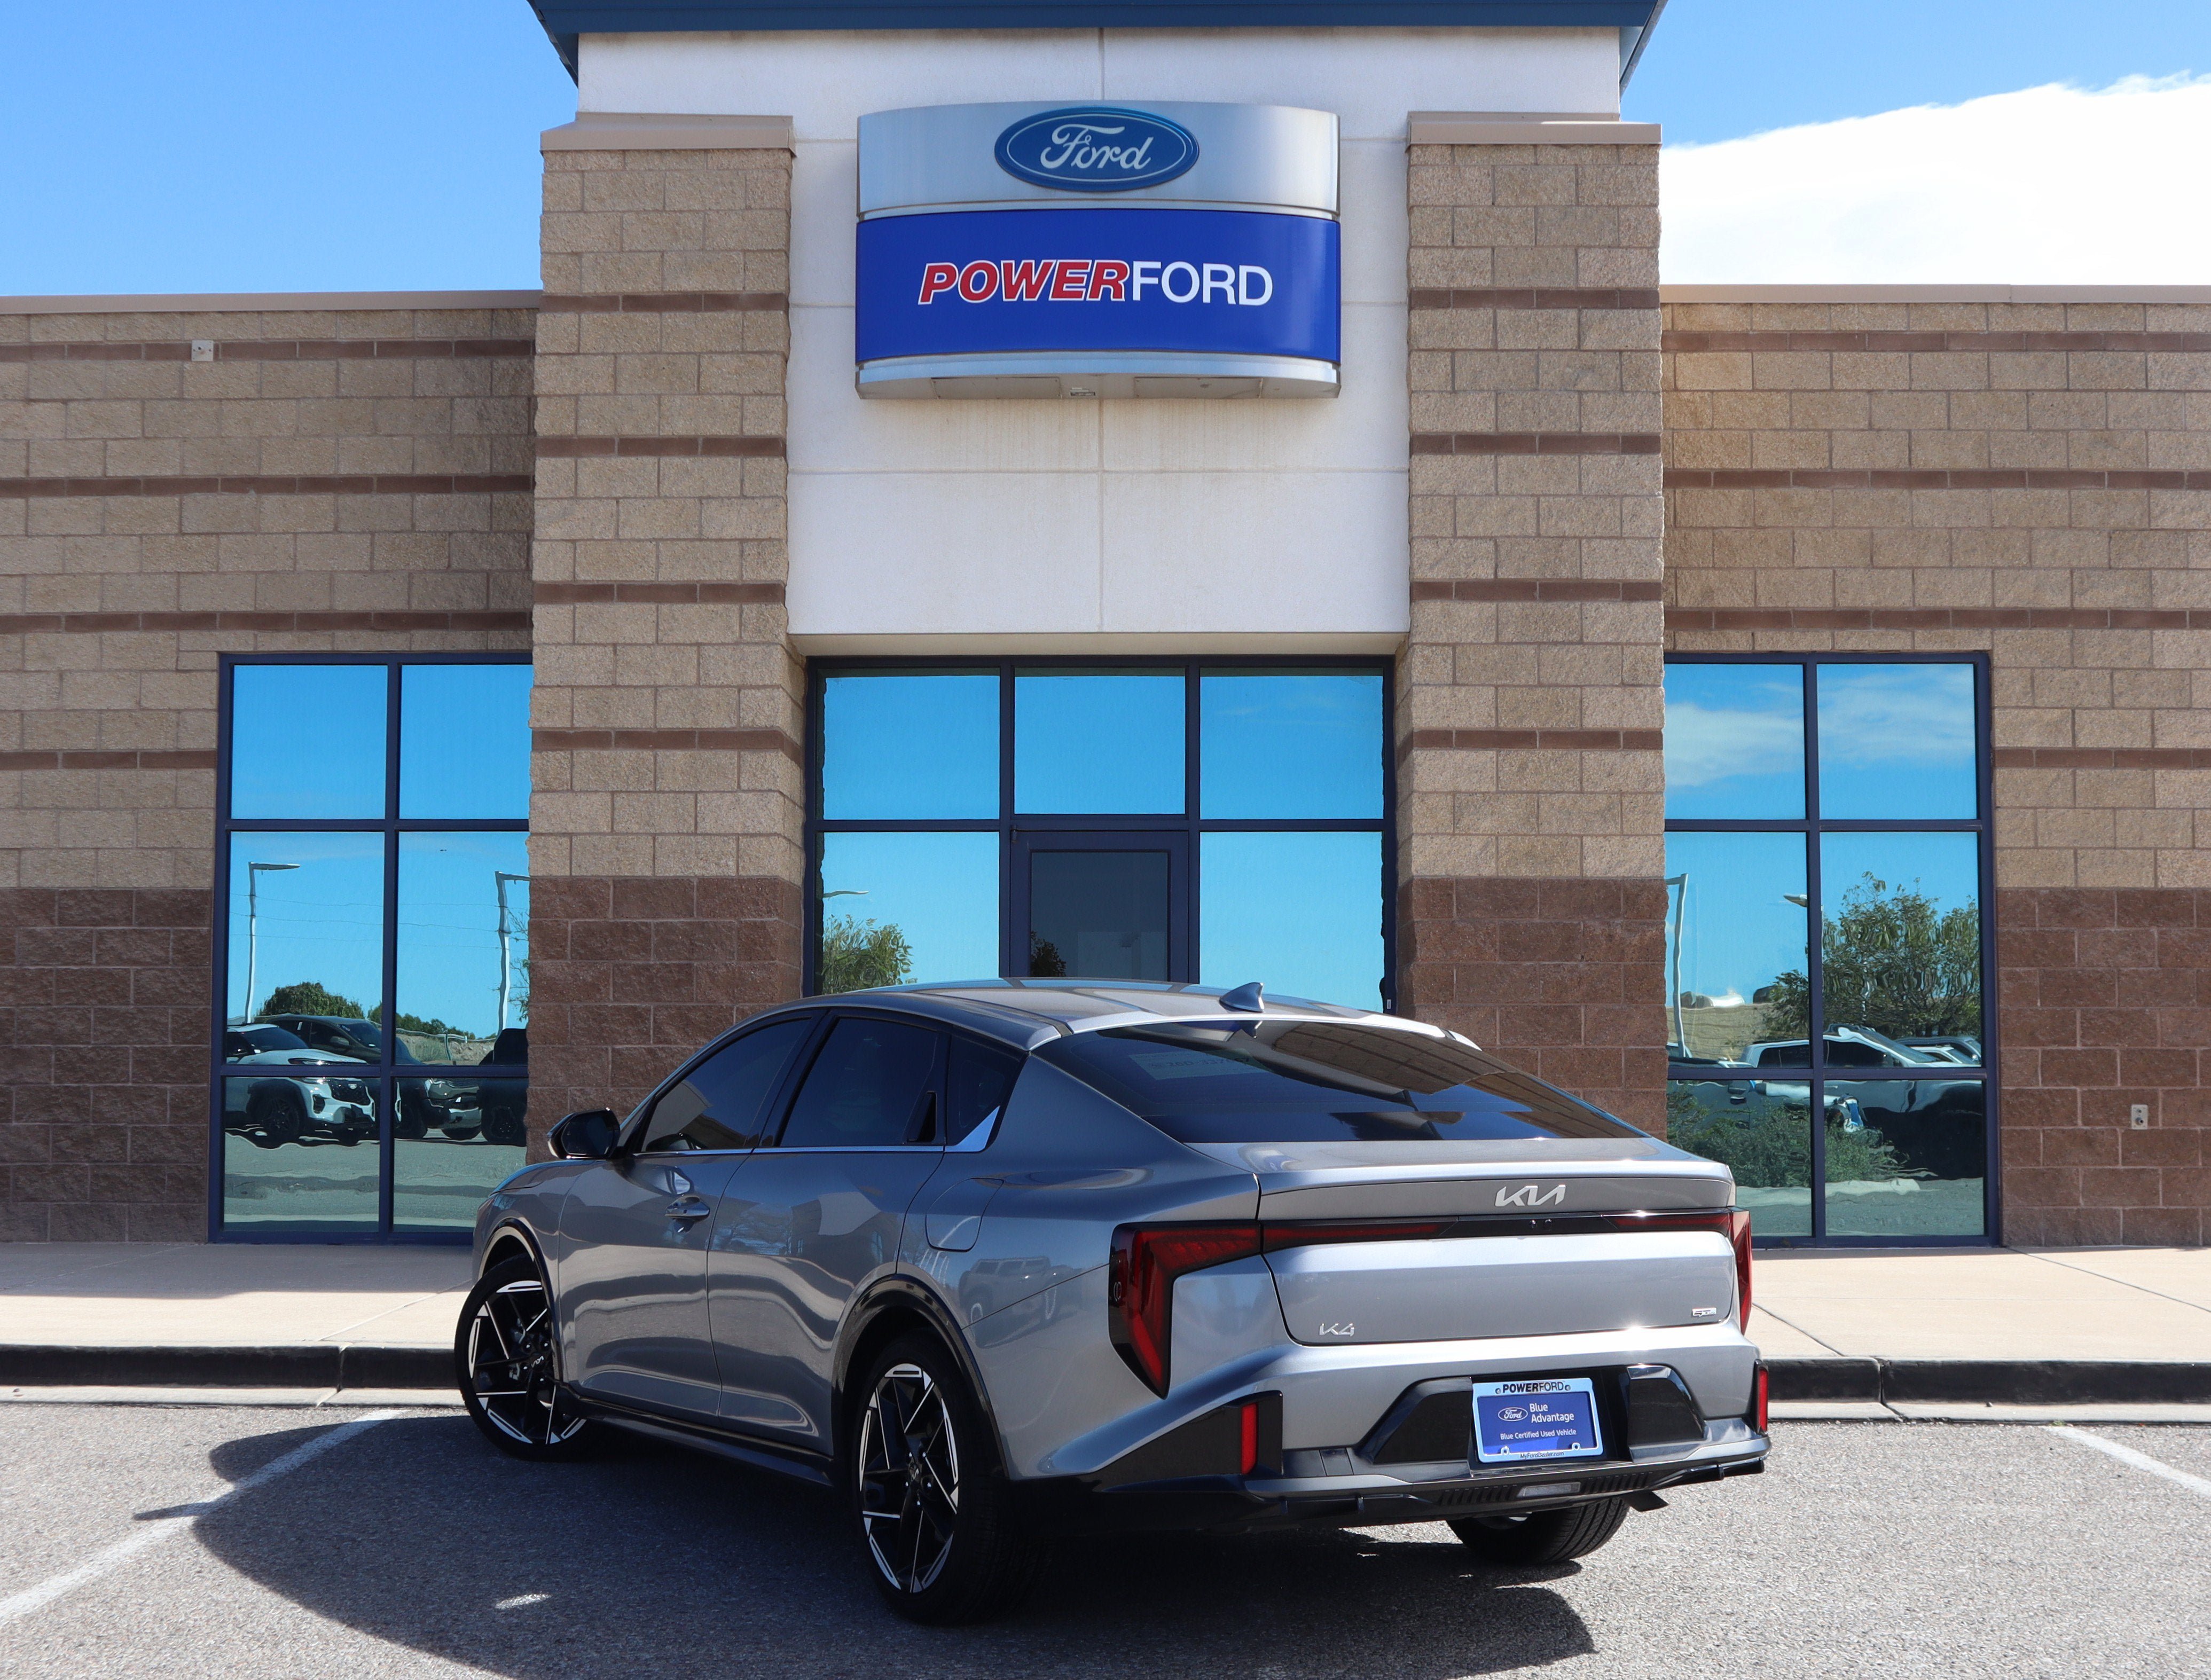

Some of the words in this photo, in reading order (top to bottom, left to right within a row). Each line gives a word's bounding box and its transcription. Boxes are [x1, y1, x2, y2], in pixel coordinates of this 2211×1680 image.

[1039, 123, 1154, 170] Ford
[918, 259, 1274, 307] POWERFORD
[1495, 1184, 1566, 1206] KIA
[1319, 1323, 1354, 1337] K4
[1502, 1381, 1564, 1393] POWERFORD
[1529, 1402, 1548, 1412] Blue
[1503, 1409, 1523, 1419] Ford
[1531, 1413, 1574, 1423] Advantage
[1515, 1431, 1539, 1439] Certified
[1556, 1428, 1577, 1436] Vehicle
